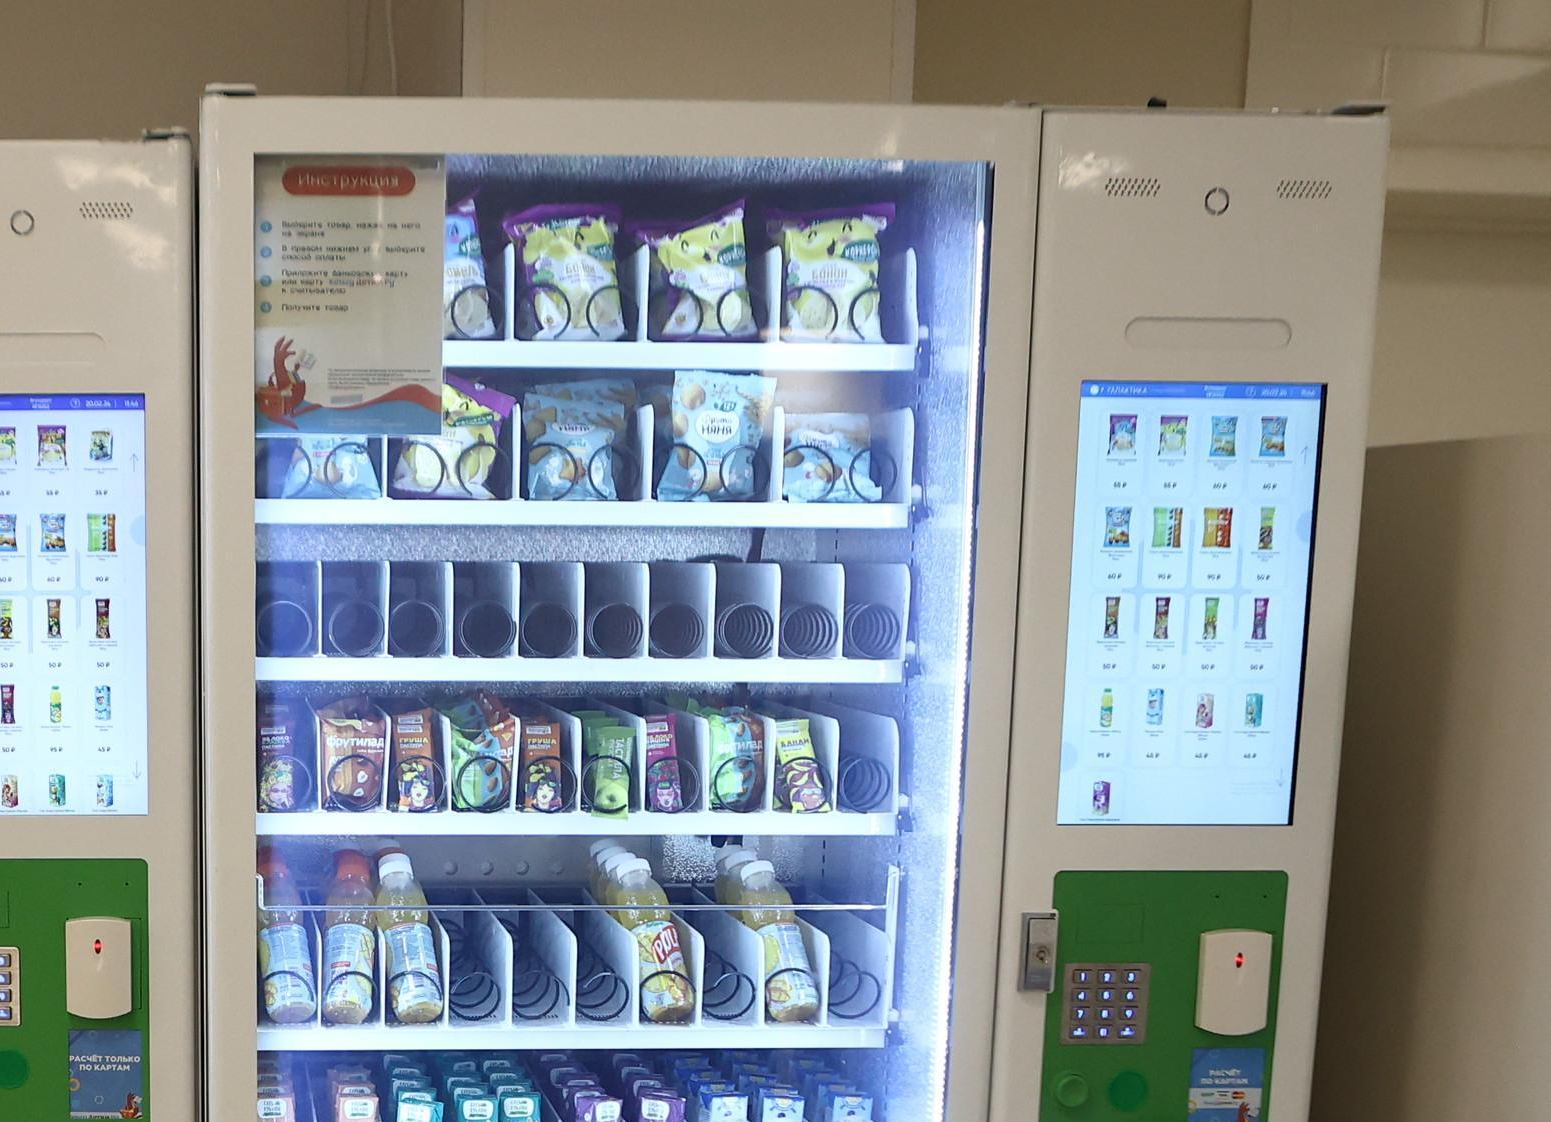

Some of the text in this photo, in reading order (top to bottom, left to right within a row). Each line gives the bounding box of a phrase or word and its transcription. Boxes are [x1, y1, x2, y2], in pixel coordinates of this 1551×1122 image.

[298, 172, 399, 191] Инструкция
[281, 269, 328, 277] Приложите
[281, 303, 349, 312] Получите товар
[69, 1054, 141, 1063] РАСЧЁТ ТОЛЬКО
